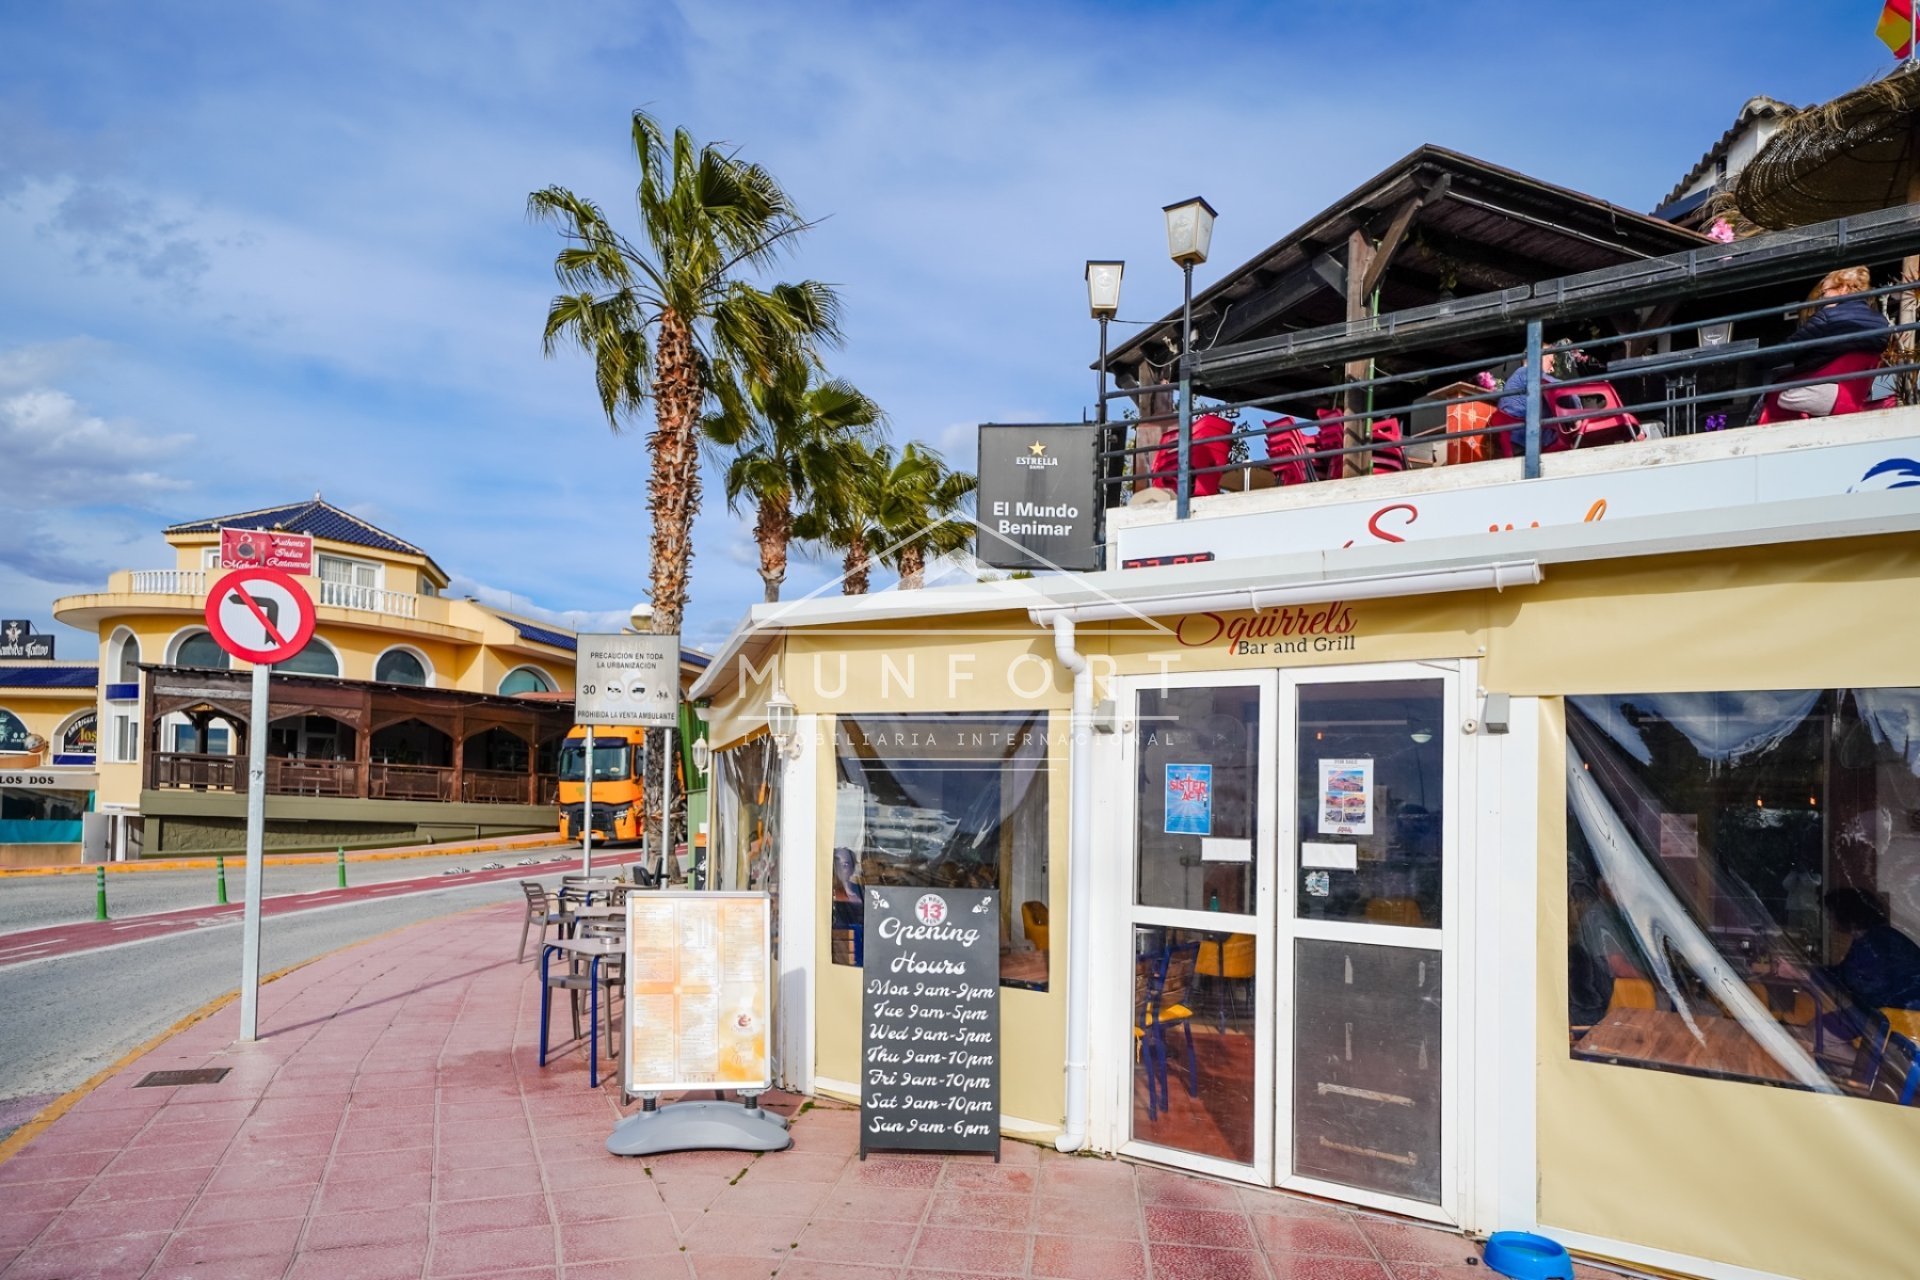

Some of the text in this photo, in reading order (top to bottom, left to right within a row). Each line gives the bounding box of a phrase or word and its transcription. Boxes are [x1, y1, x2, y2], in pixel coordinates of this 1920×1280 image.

[1016, 456, 1058, 466] ESTRELLA
[993, 501, 1078, 518] El Mundo
[998, 520, 1072, 536] Benimar
[1238, 636, 1356, 656] Bar and Grill
[582, 685, 596, 695] 30
[578, 710, 609, 718] PROHIBIDA
[639, 712, 675, 720] AMBULANTE
[30, 776, 54, 784] DOS
[1169, 776, 1207, 792] SISTER
[1182, 790, 1201, 801] ACT
[921, 904, 942, 919] 13
[878, 917, 980, 947] Opening
[890, 950, 966, 974] Hours
[867, 979, 995, 1000] Mon 9am-9pm
[873, 1000, 989, 1022] Tue 9am-5pm
[870, 1023, 992, 1045] Wed 9am-5pm
[867, 1045, 993, 1068] Thu 9am-10pm
[870, 1069, 991, 1092] Fri 9am-10pm
[866, 1092, 992, 1115] Sat 9am-10pm
[868, 1115, 990, 1137] Sun 9am-6pm
